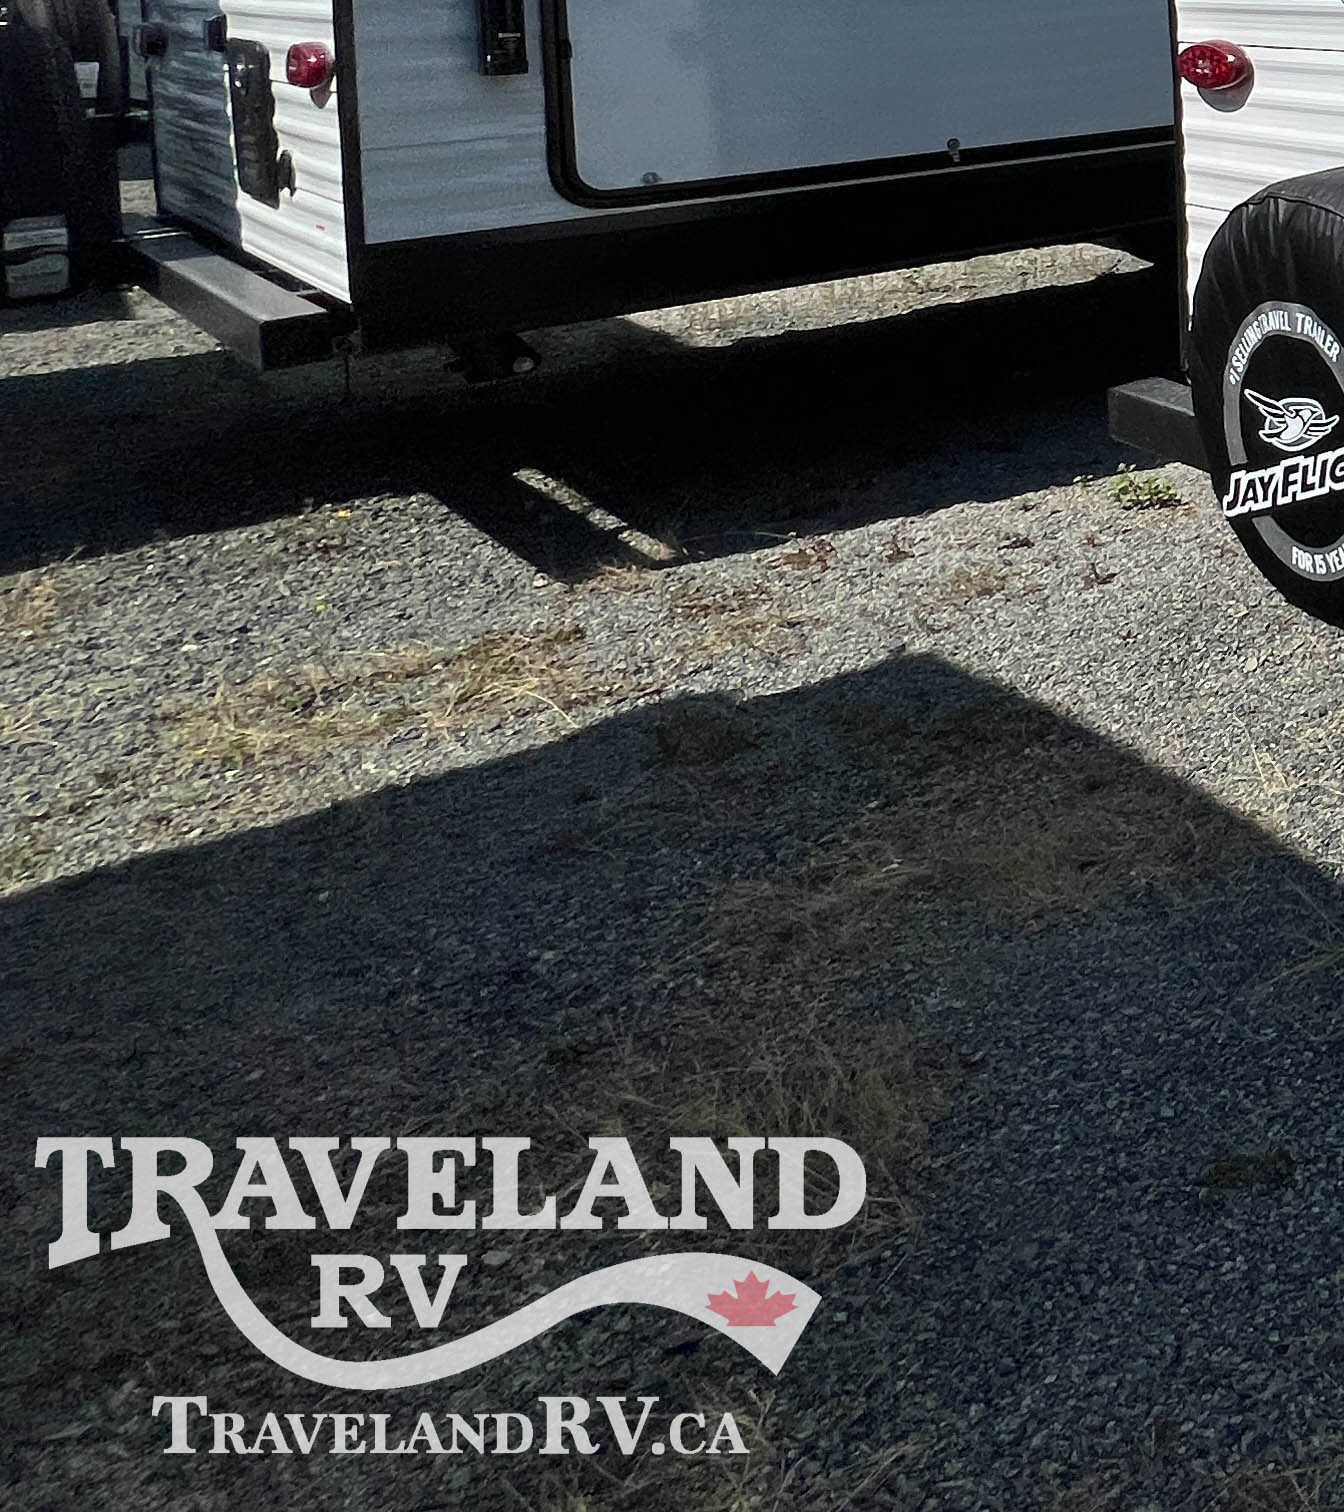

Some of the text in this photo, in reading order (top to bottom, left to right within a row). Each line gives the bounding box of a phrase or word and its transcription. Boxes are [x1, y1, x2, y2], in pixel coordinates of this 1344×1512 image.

[1295, 312, 1341, 363] TRAILER
[1291, 546, 1315, 574] FOR
[1313, 553, 1327, 575] 15
